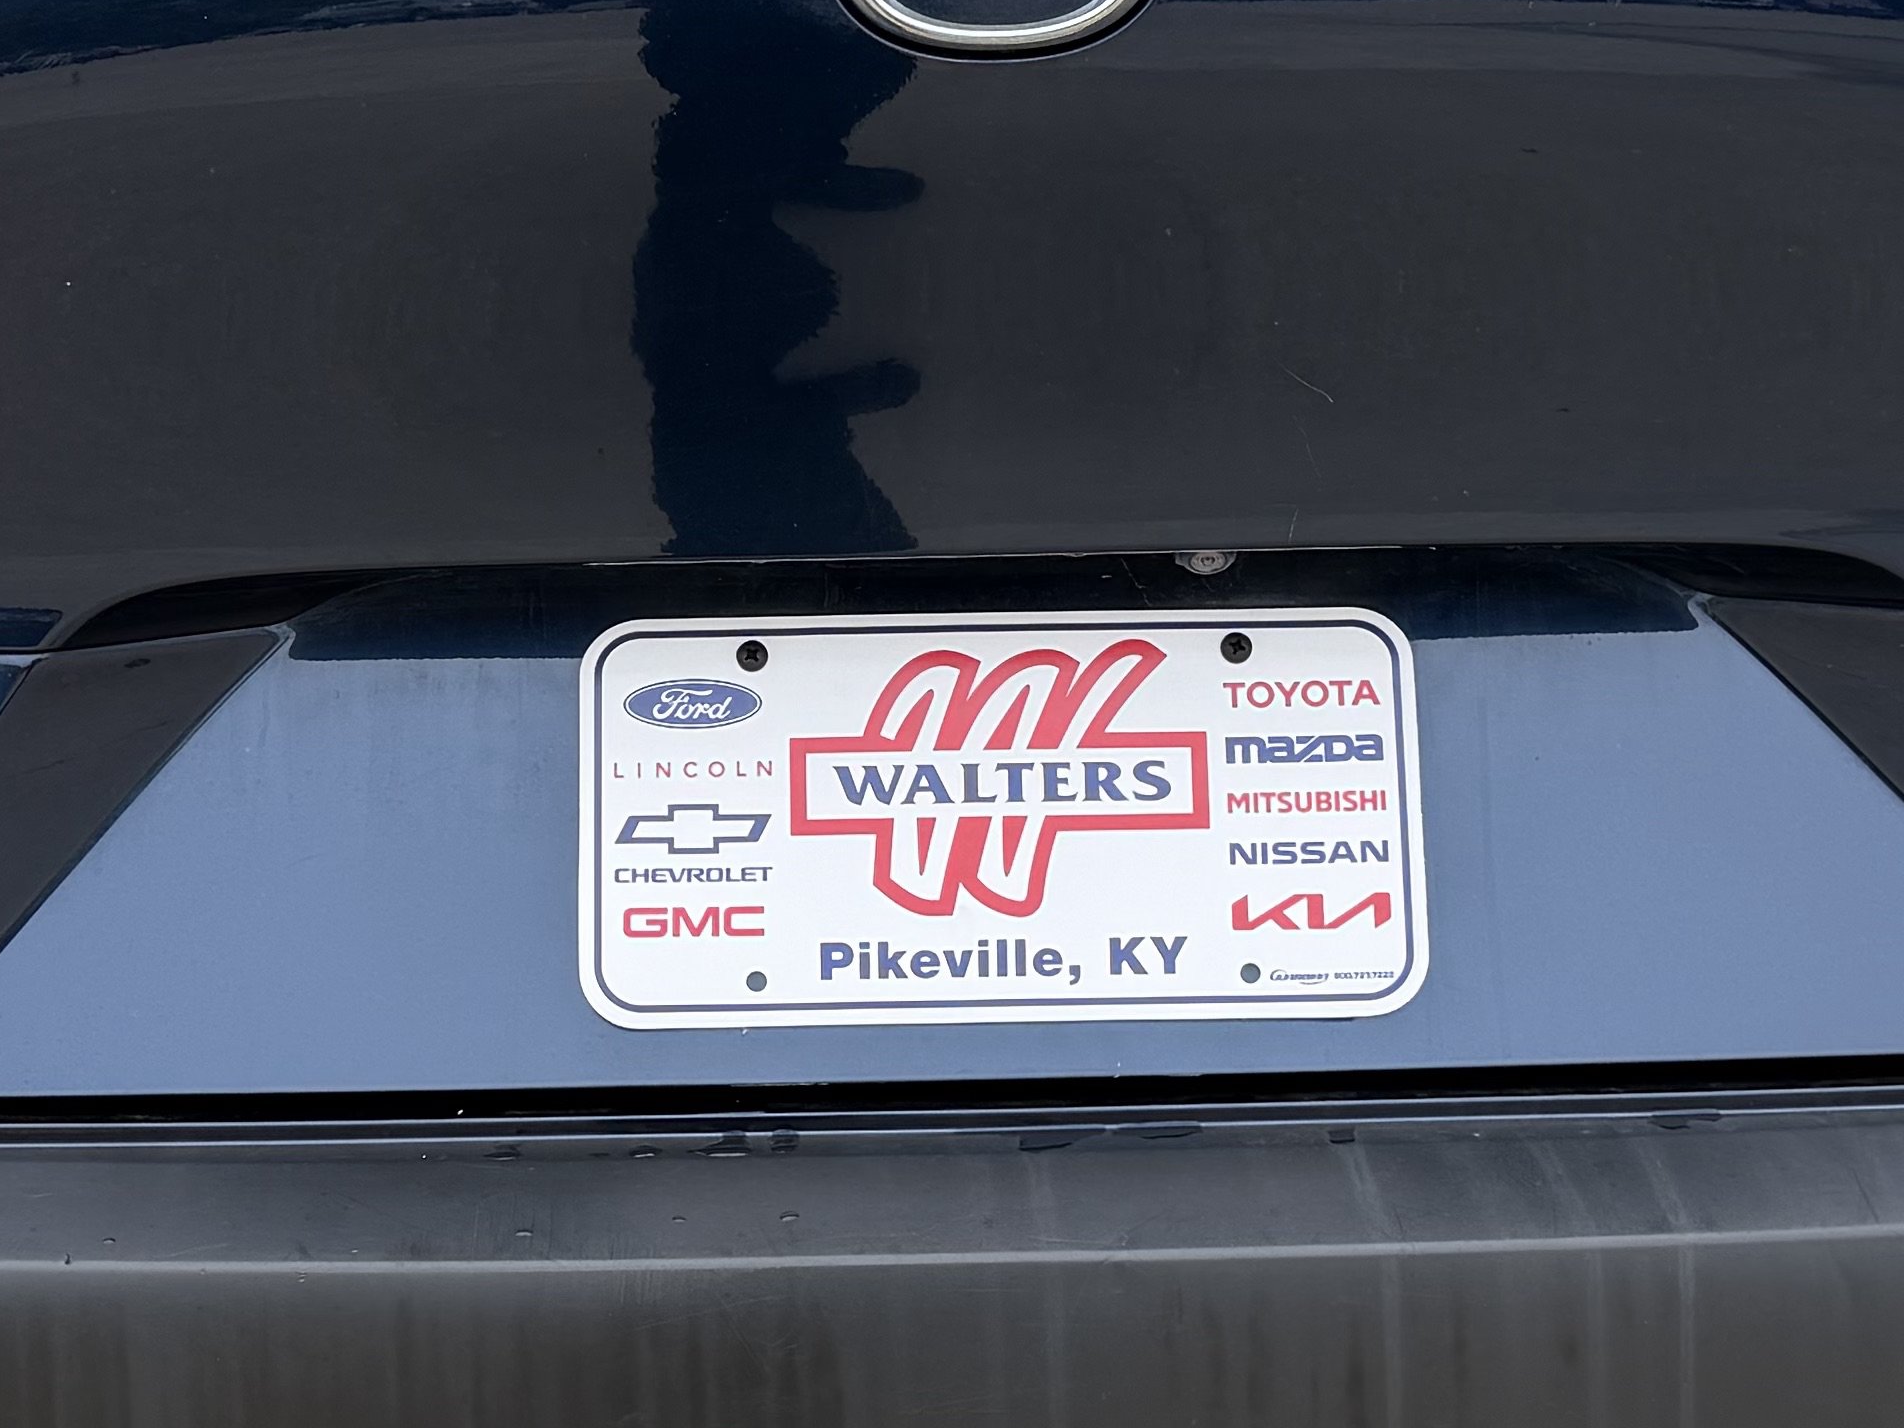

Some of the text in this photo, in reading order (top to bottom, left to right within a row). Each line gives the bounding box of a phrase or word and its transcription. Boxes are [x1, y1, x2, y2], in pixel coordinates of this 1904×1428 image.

[652, 688, 732, 721] Ford
[1222, 679, 1381, 709] TOYOTA
[613, 760, 773, 779] LINCOLN
[832, 759, 1171, 806] WALTERS
[1227, 790, 1387, 814] MITSUBISHI
[1229, 839, 1389, 865] NISSAN
[614, 866, 773, 884] CHEVROLET
[623, 906, 765, 938] GMC
[819, 936, 1188, 986] Pikeville, KY
